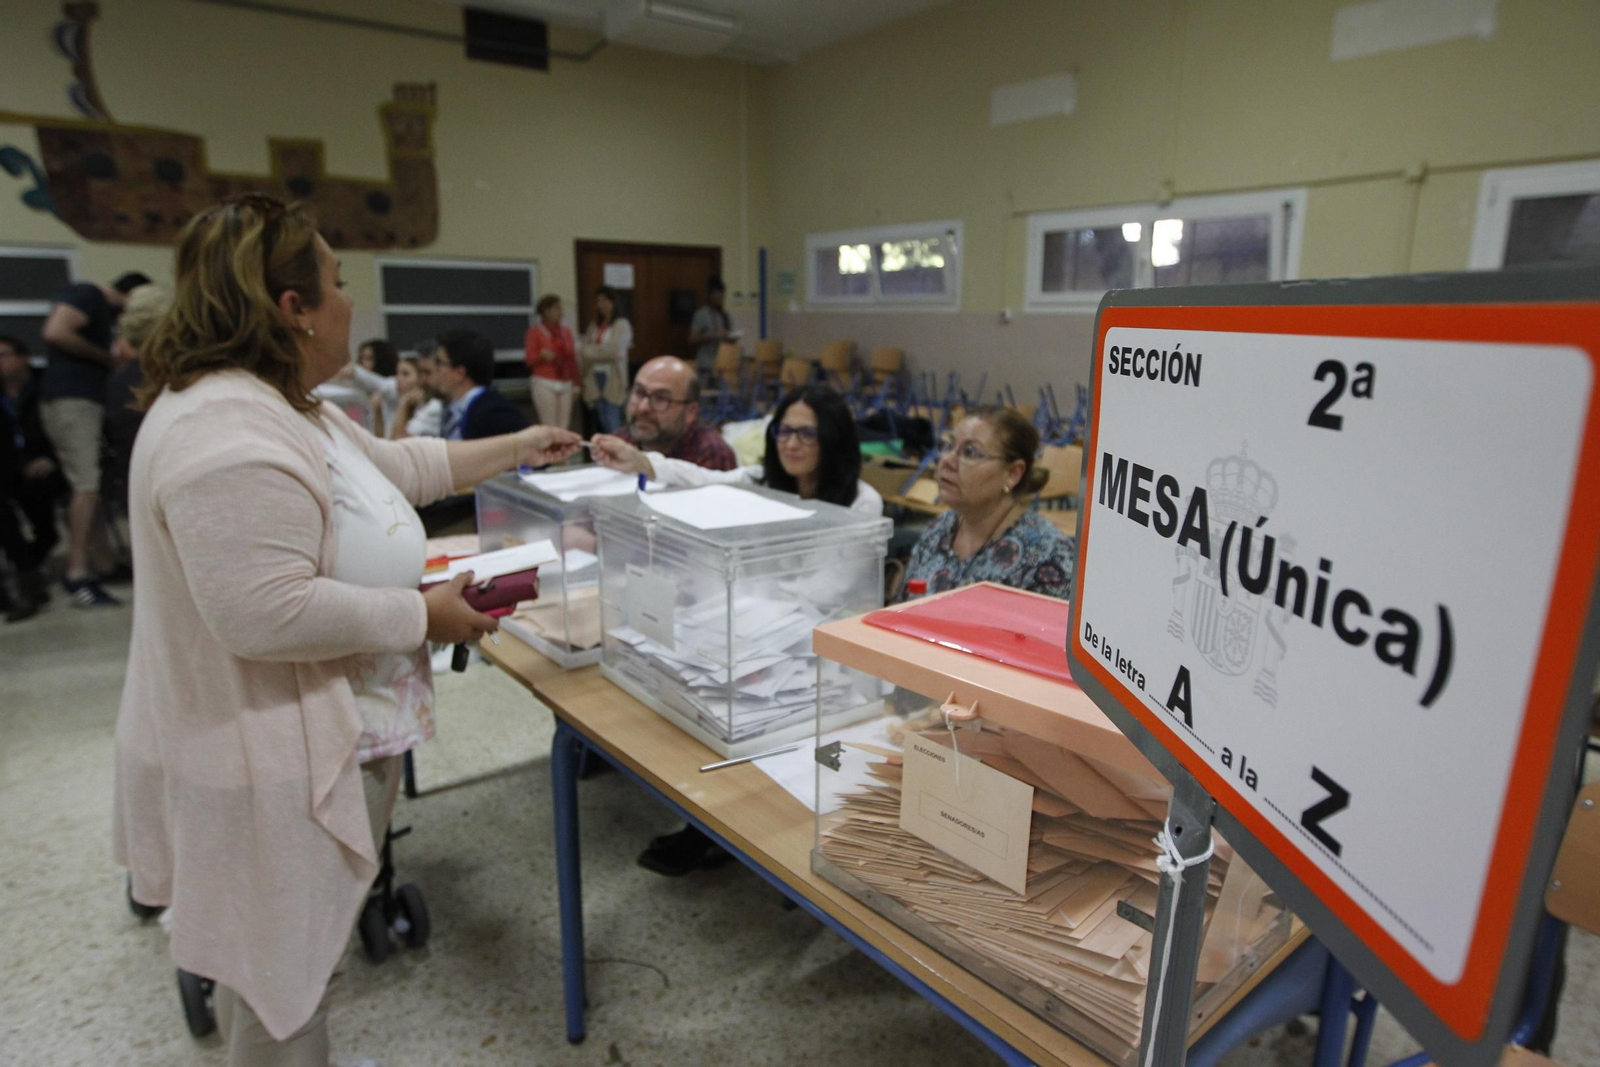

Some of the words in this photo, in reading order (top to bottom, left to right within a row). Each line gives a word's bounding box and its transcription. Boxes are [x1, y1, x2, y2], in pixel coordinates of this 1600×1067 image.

[1108, 343, 1203, 388] SECCIÓN
[1307, 359, 1376, 431] 2ª
[1099, 452, 1211, 559] MESA
[1219, 516, 1456, 709] (Única)
[913, 744, 946, 763] ELECCIONES
[1084, 621, 1099, 649] De
[1101, 637, 1112, 662] la
[1115, 649, 1146, 692] letra
[1166, 664, 1193, 729] A
[1220, 746, 1233, 770] a
[1239, 755, 1259, 793] la
[1300, 765, 1352, 859] Z
